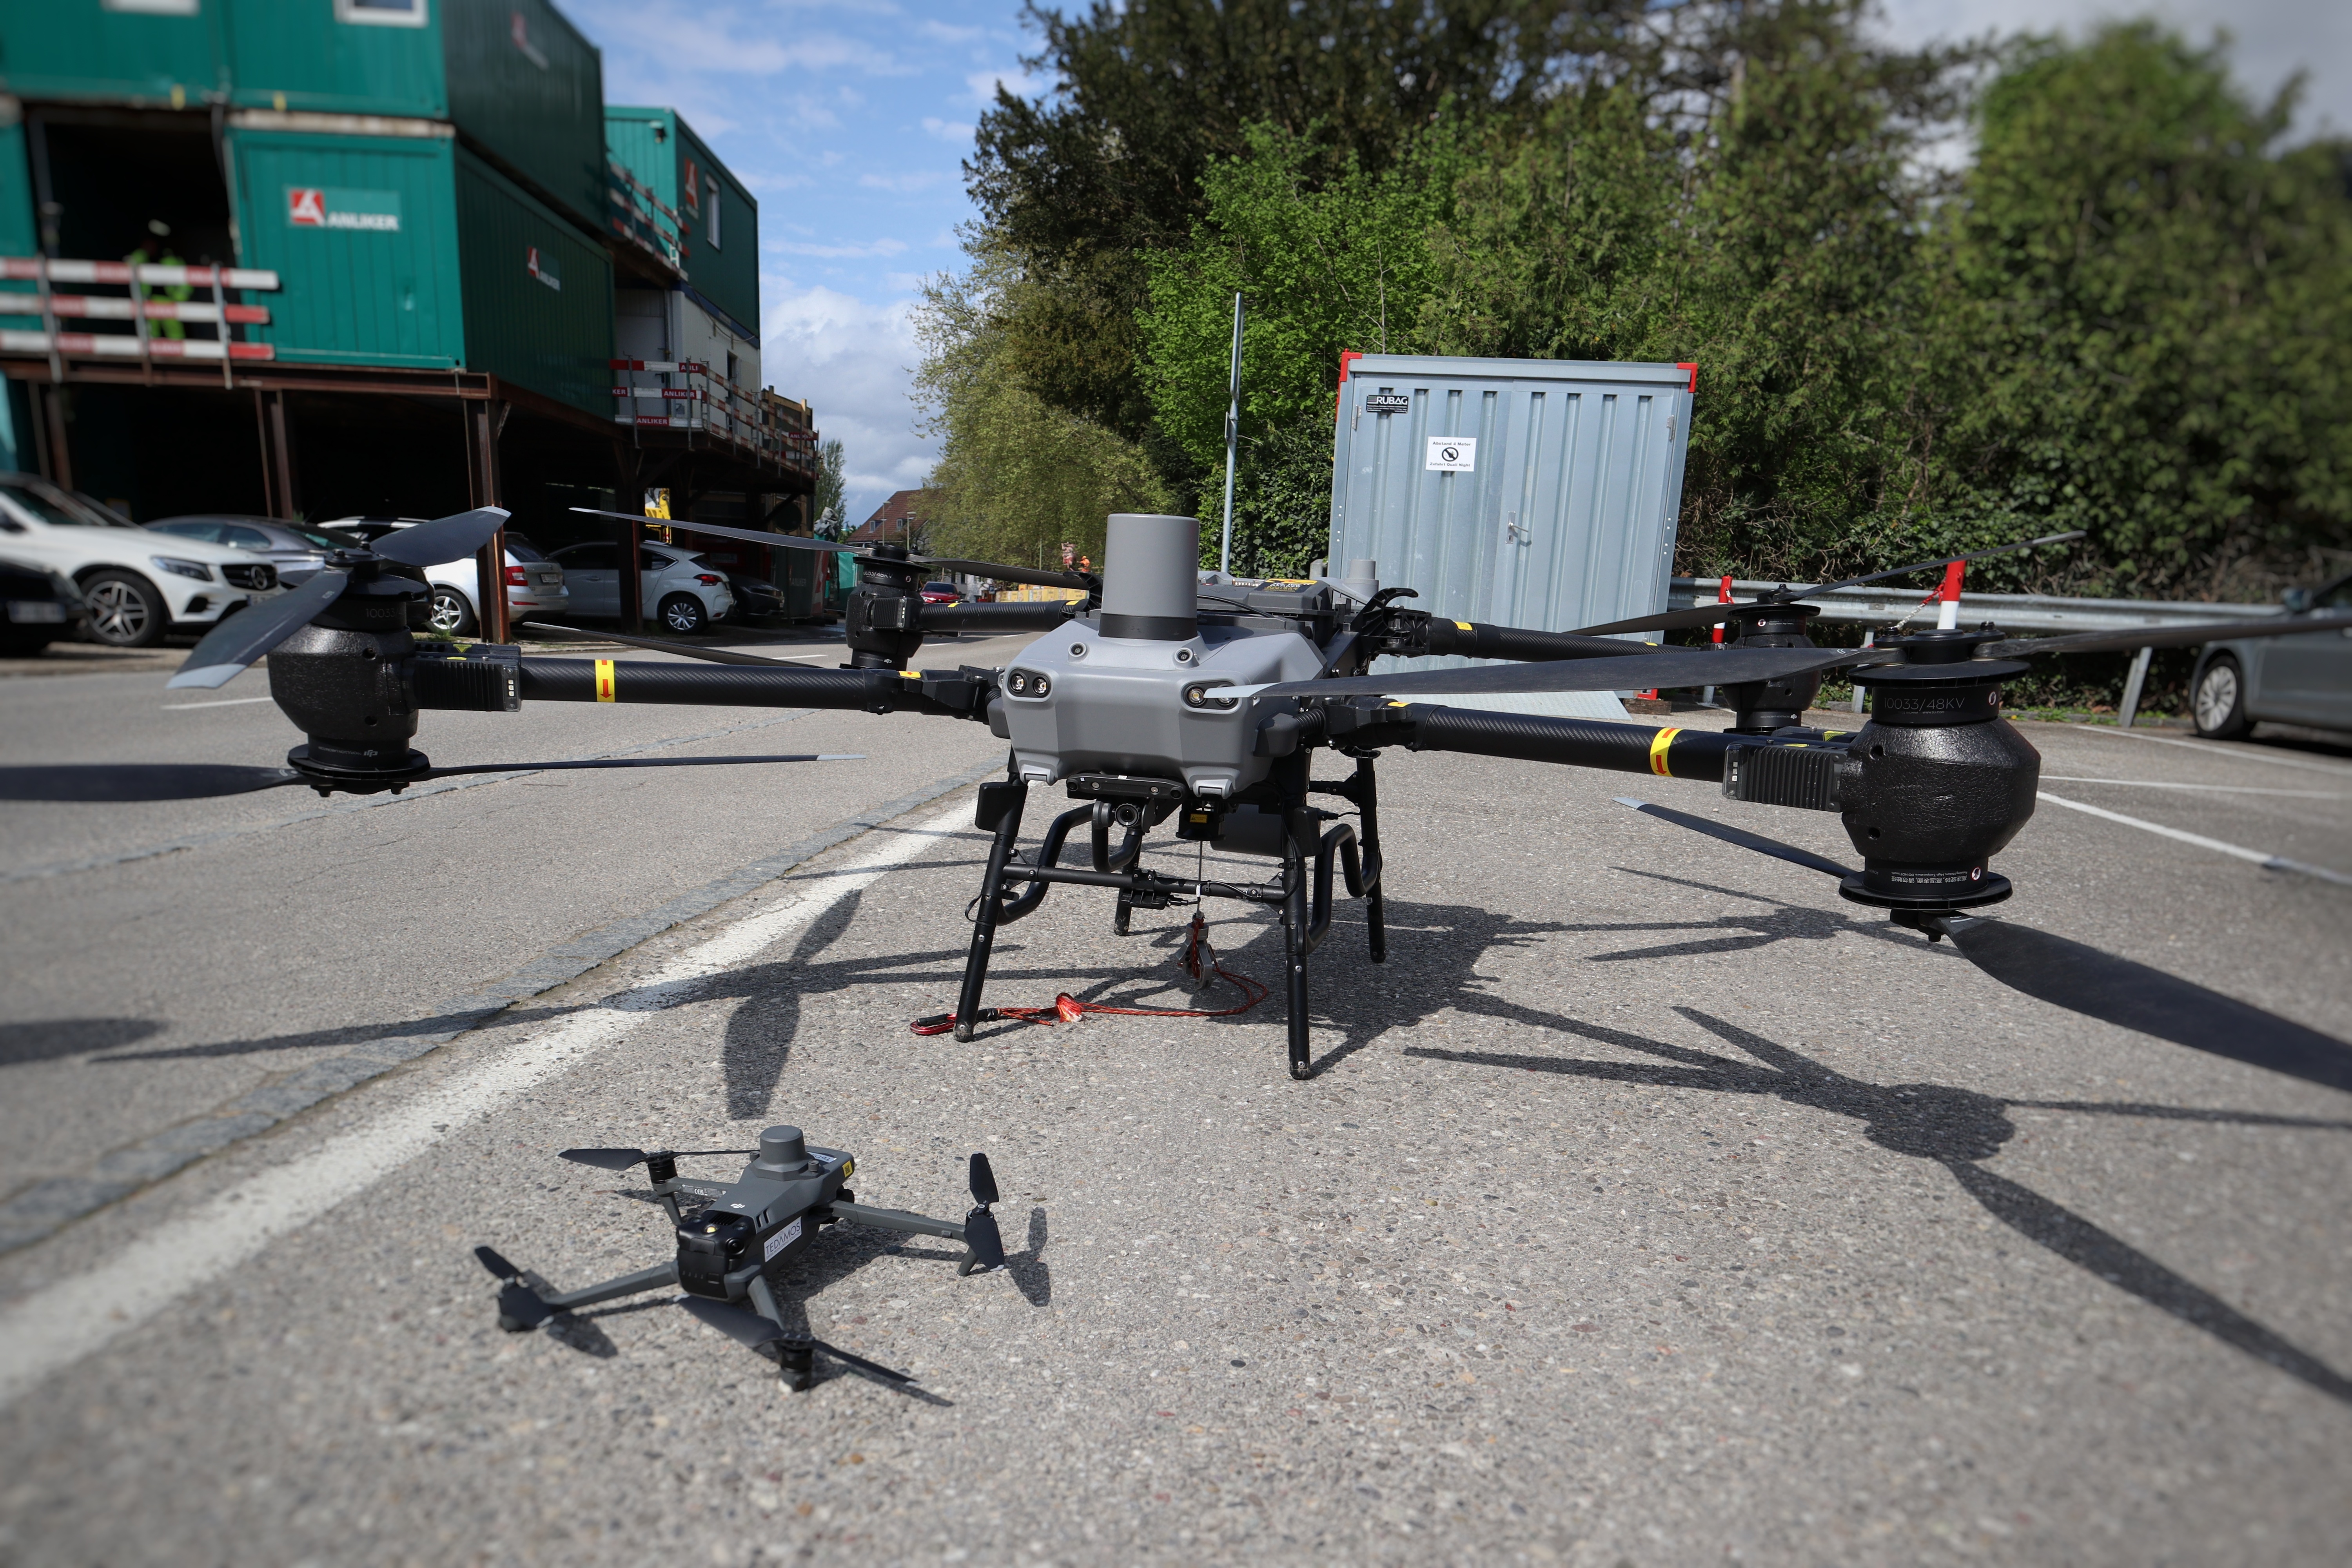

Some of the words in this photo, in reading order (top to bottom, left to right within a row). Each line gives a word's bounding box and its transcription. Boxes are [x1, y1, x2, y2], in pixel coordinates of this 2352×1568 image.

[327, 212, 399, 230] ANLIKER
[1377, 396, 1407, 405] RUBAG
[1884, 697, 1965, 711] 10033/48KV
[766, 1222, 800, 1255] TEDAMOS
